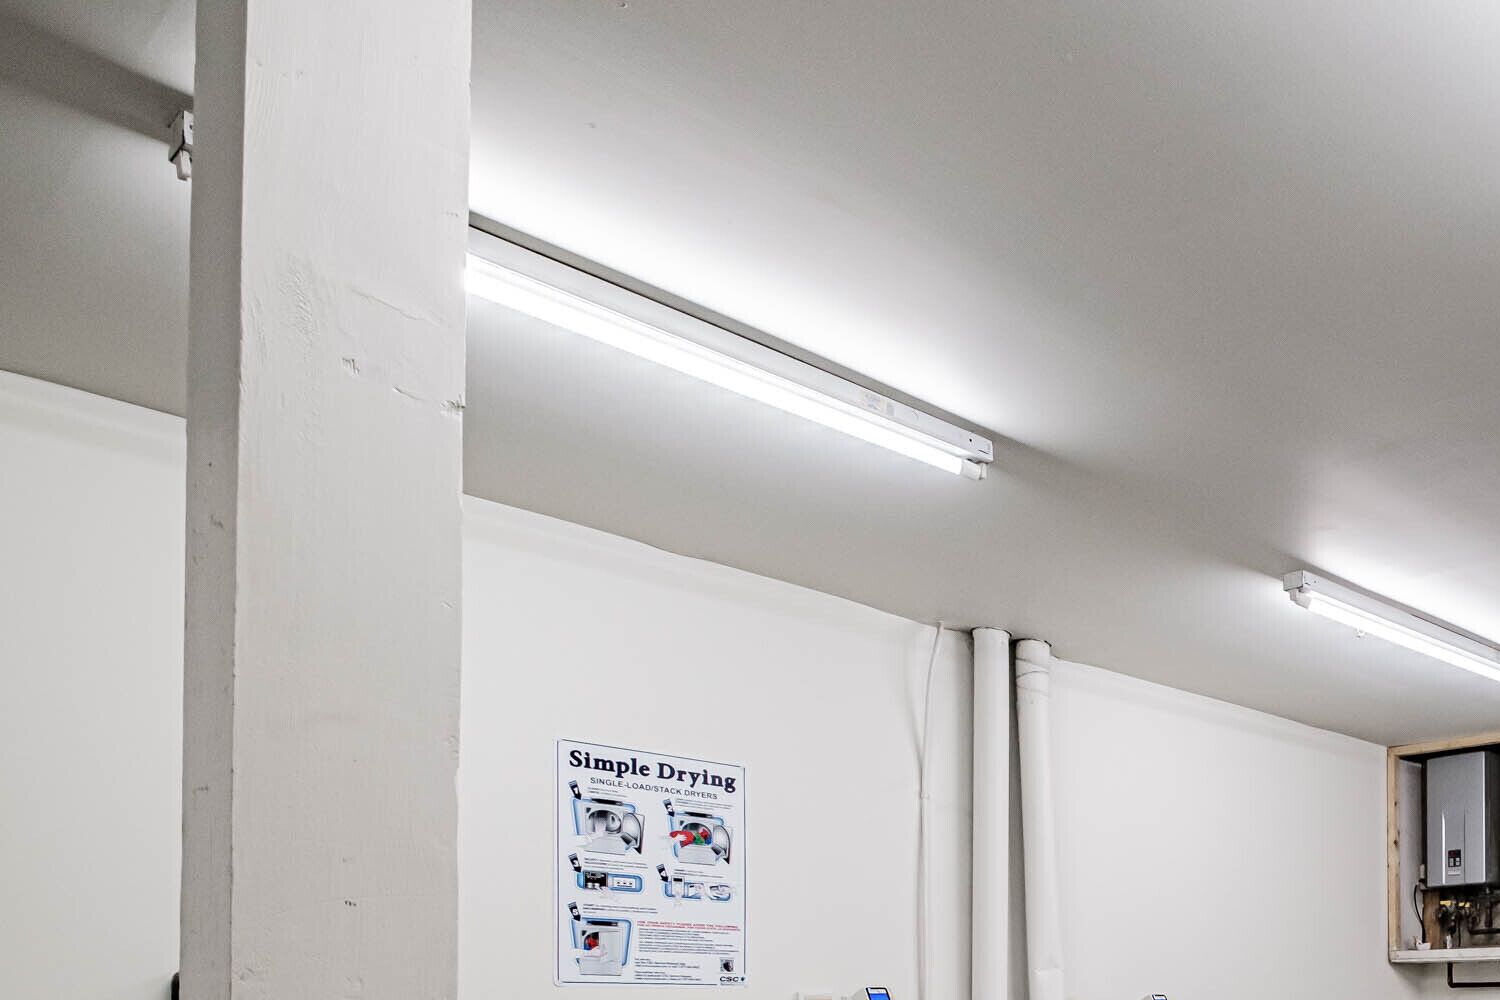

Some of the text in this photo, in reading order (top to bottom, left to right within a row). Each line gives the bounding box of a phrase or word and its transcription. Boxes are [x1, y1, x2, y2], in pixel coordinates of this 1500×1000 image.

[569, 750, 737, 793] Simple Drying
[590, 777, 682, 795] SINGLE-LOAD/STACK
[684, 789, 718, 800] DRYERS
